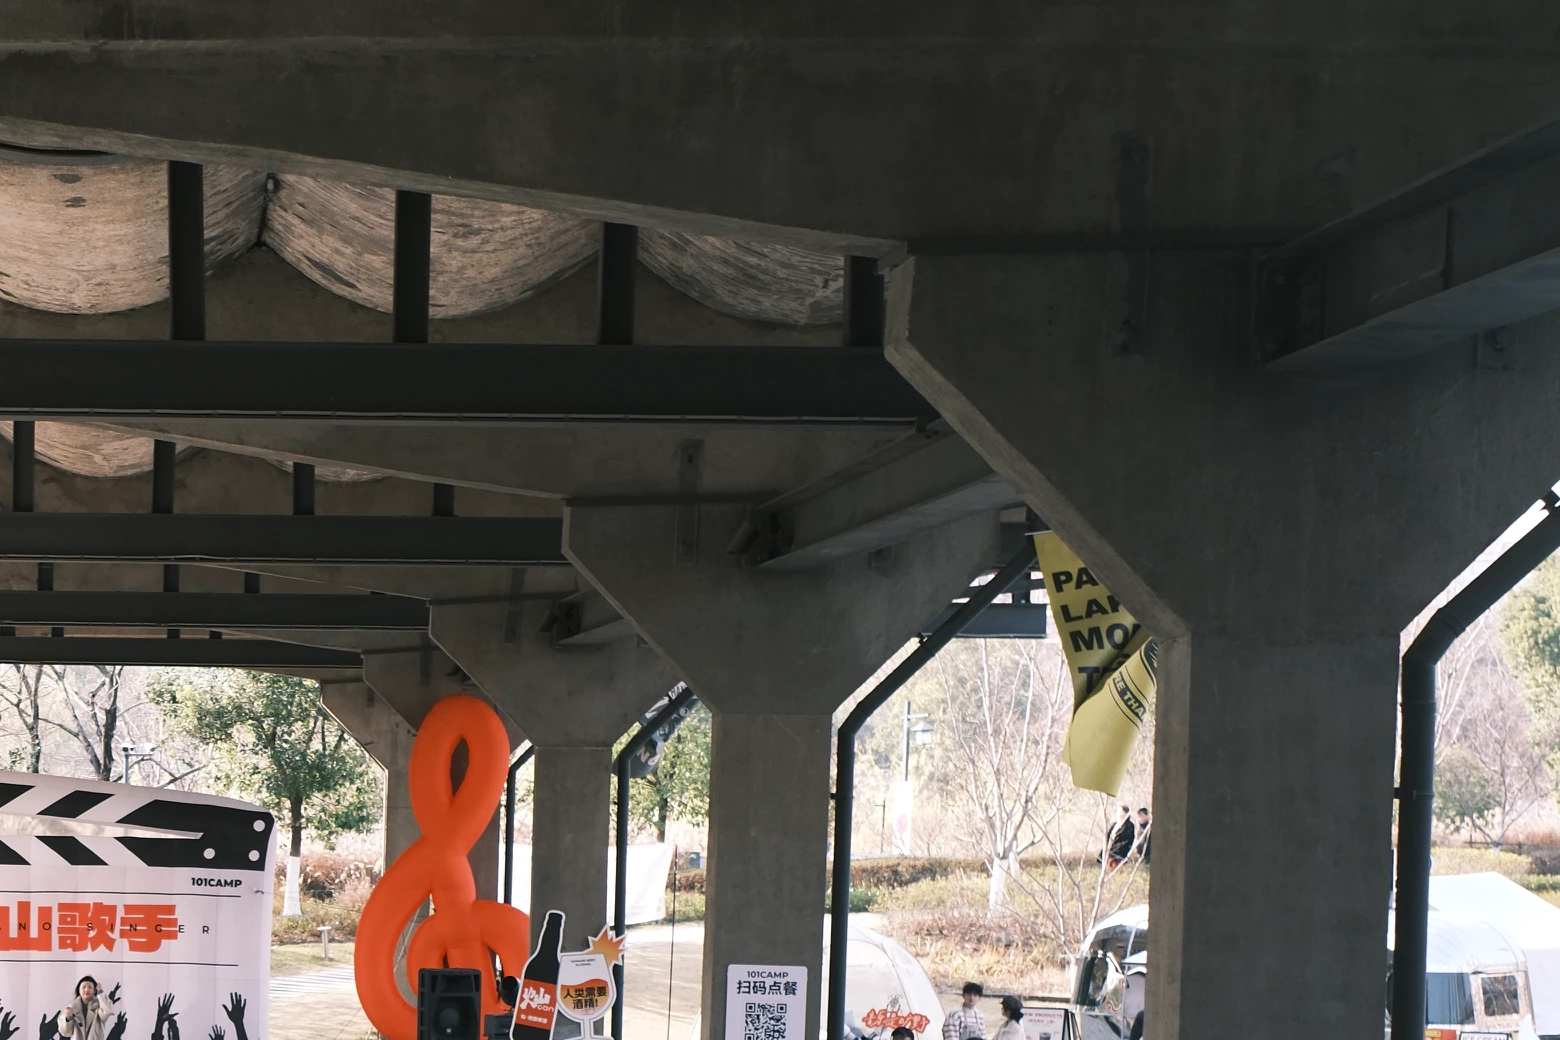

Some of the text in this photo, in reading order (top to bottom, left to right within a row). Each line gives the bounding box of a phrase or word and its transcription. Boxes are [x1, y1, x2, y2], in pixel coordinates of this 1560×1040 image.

[191, 877, 242, 888] 101CAMP
[747, 971, 789, 979] 101CAMP
[563, 986, 608, 1000] 人类需要
[737, 980, 798, 996] 扫码点餐
[572, 998, 598, 1010] 酒精!
